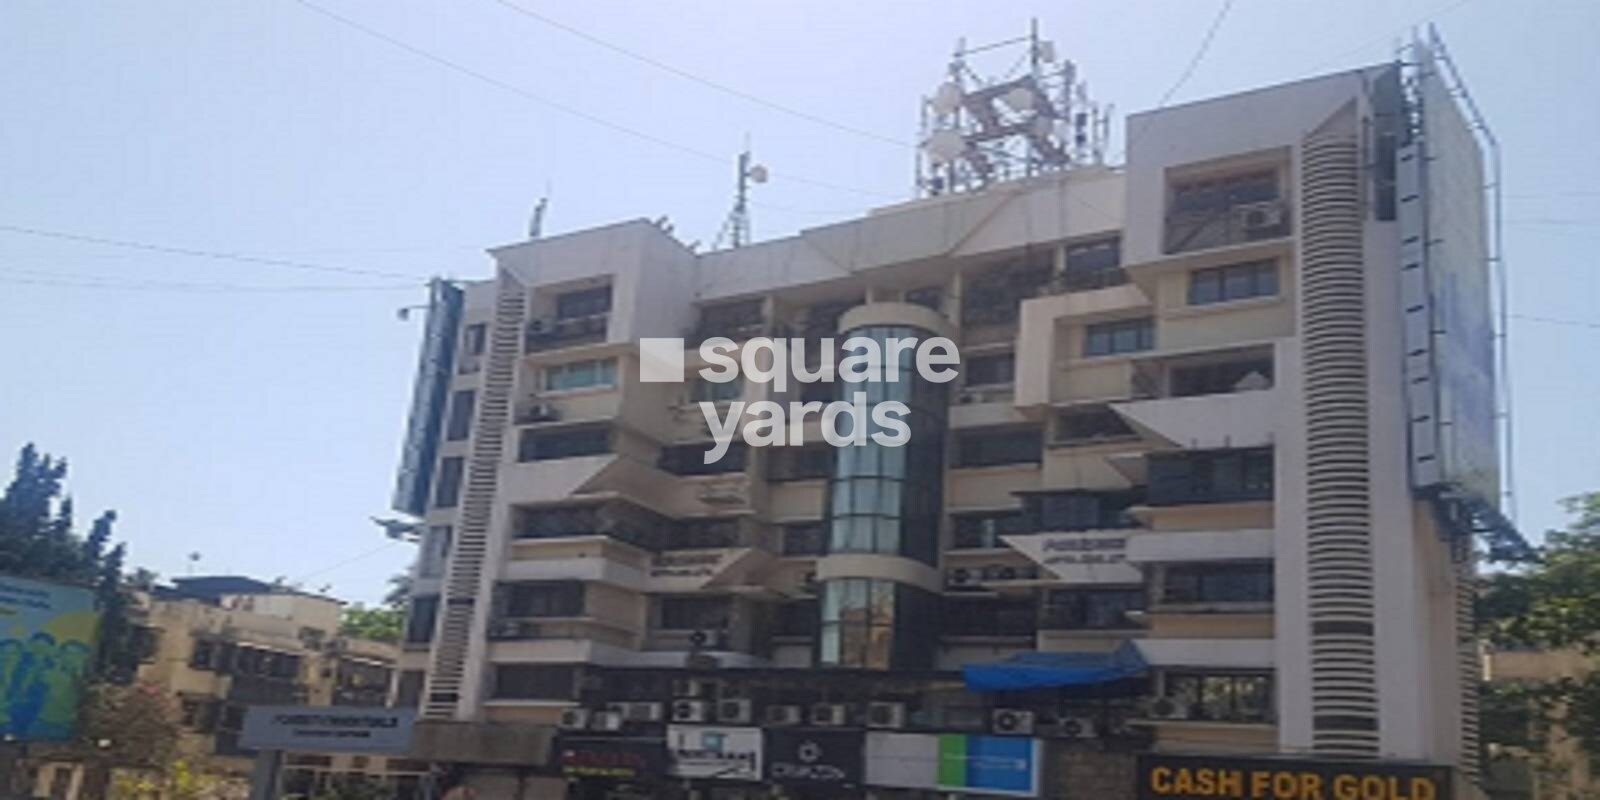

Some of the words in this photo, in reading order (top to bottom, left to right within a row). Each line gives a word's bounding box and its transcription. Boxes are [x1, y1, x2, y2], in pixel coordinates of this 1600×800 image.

[1151, 766, 1244, 797] CASH
[1251, 770, 1322, 800] FOR
[1332, 774, 1436, 800] GOLD
